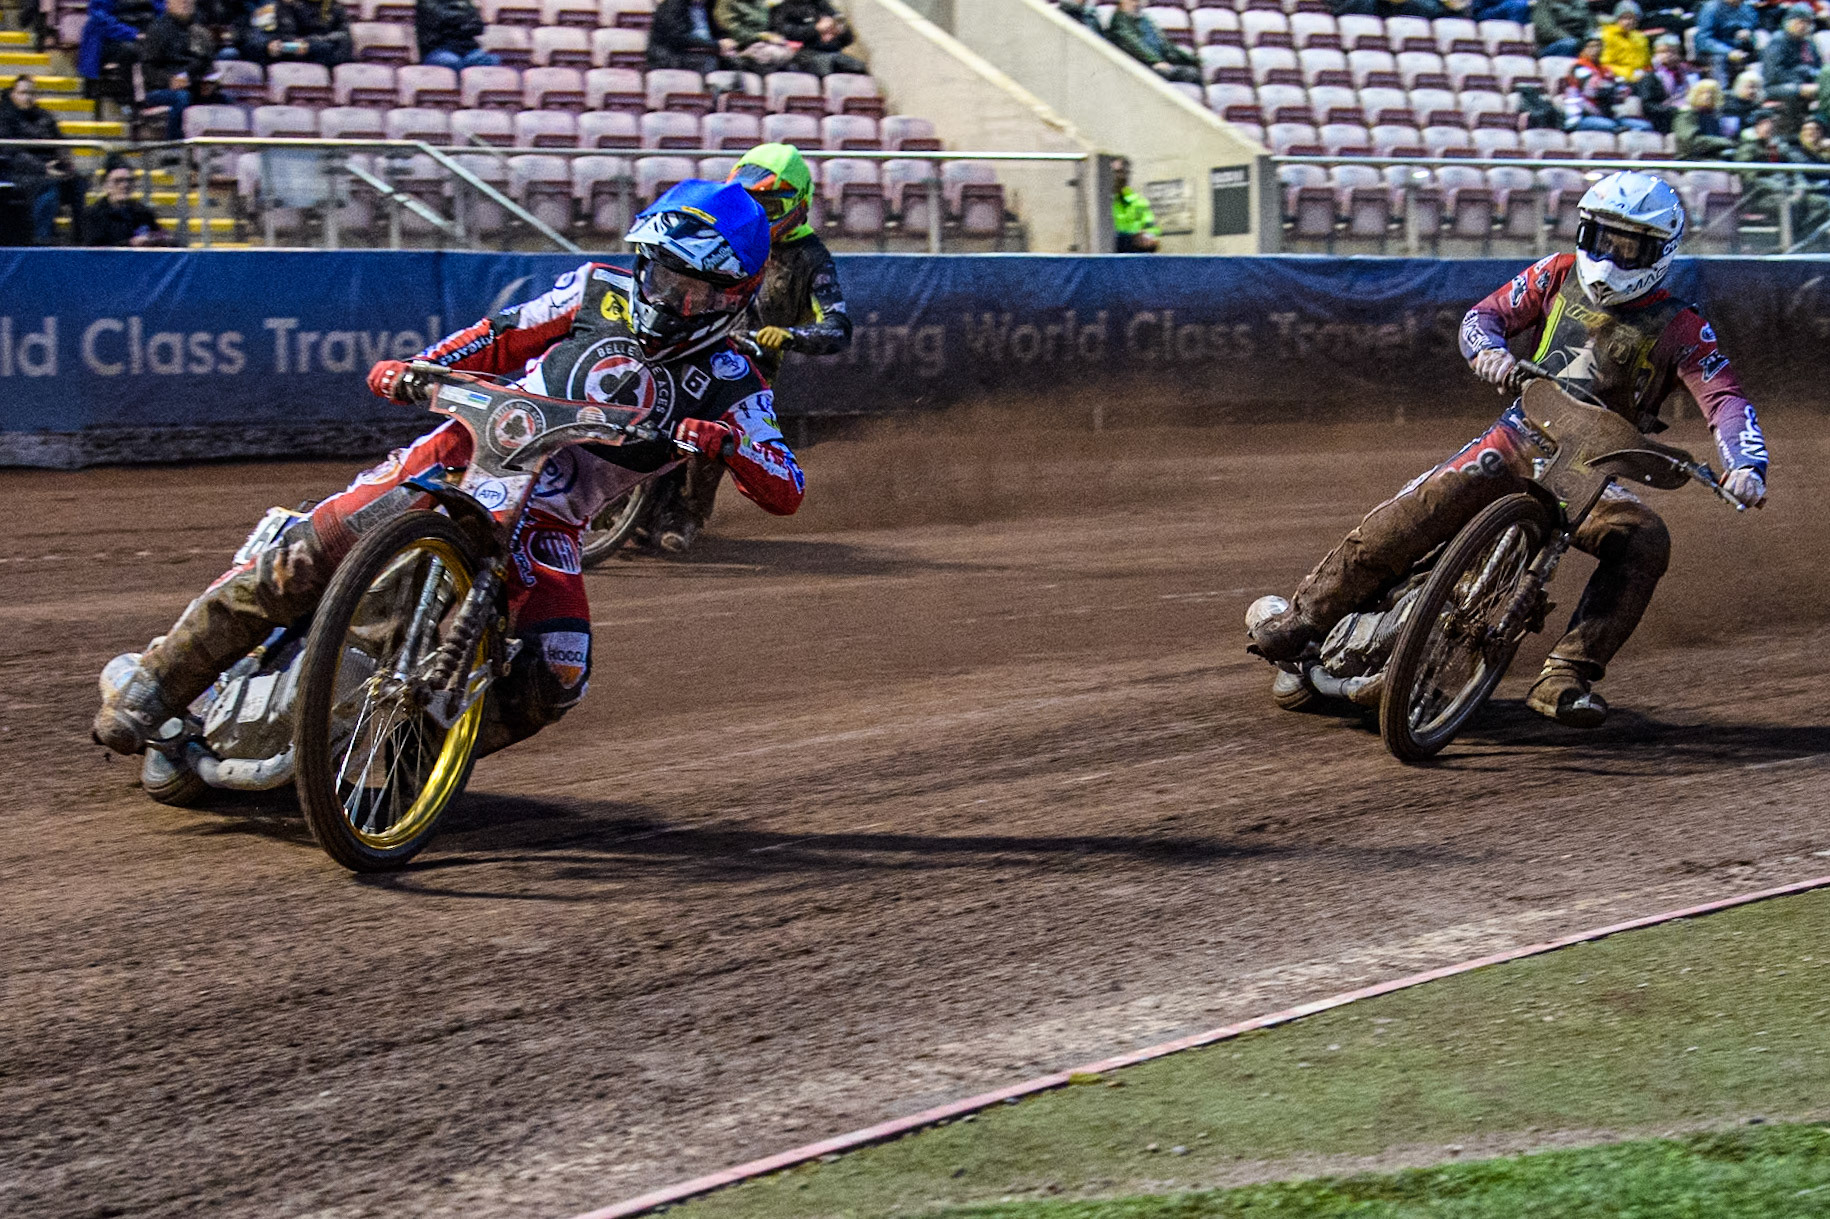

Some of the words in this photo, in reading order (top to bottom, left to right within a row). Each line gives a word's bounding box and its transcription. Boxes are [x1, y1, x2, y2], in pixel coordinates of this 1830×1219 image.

[82, 316, 246, 376] Class
[263, 315, 442, 373] Travel
[963, 309, 1109, 361] World
[1126, 309, 1256, 361] Class
[596, 343, 636, 357] BELLE
[656, 380, 669, 413] ACES
